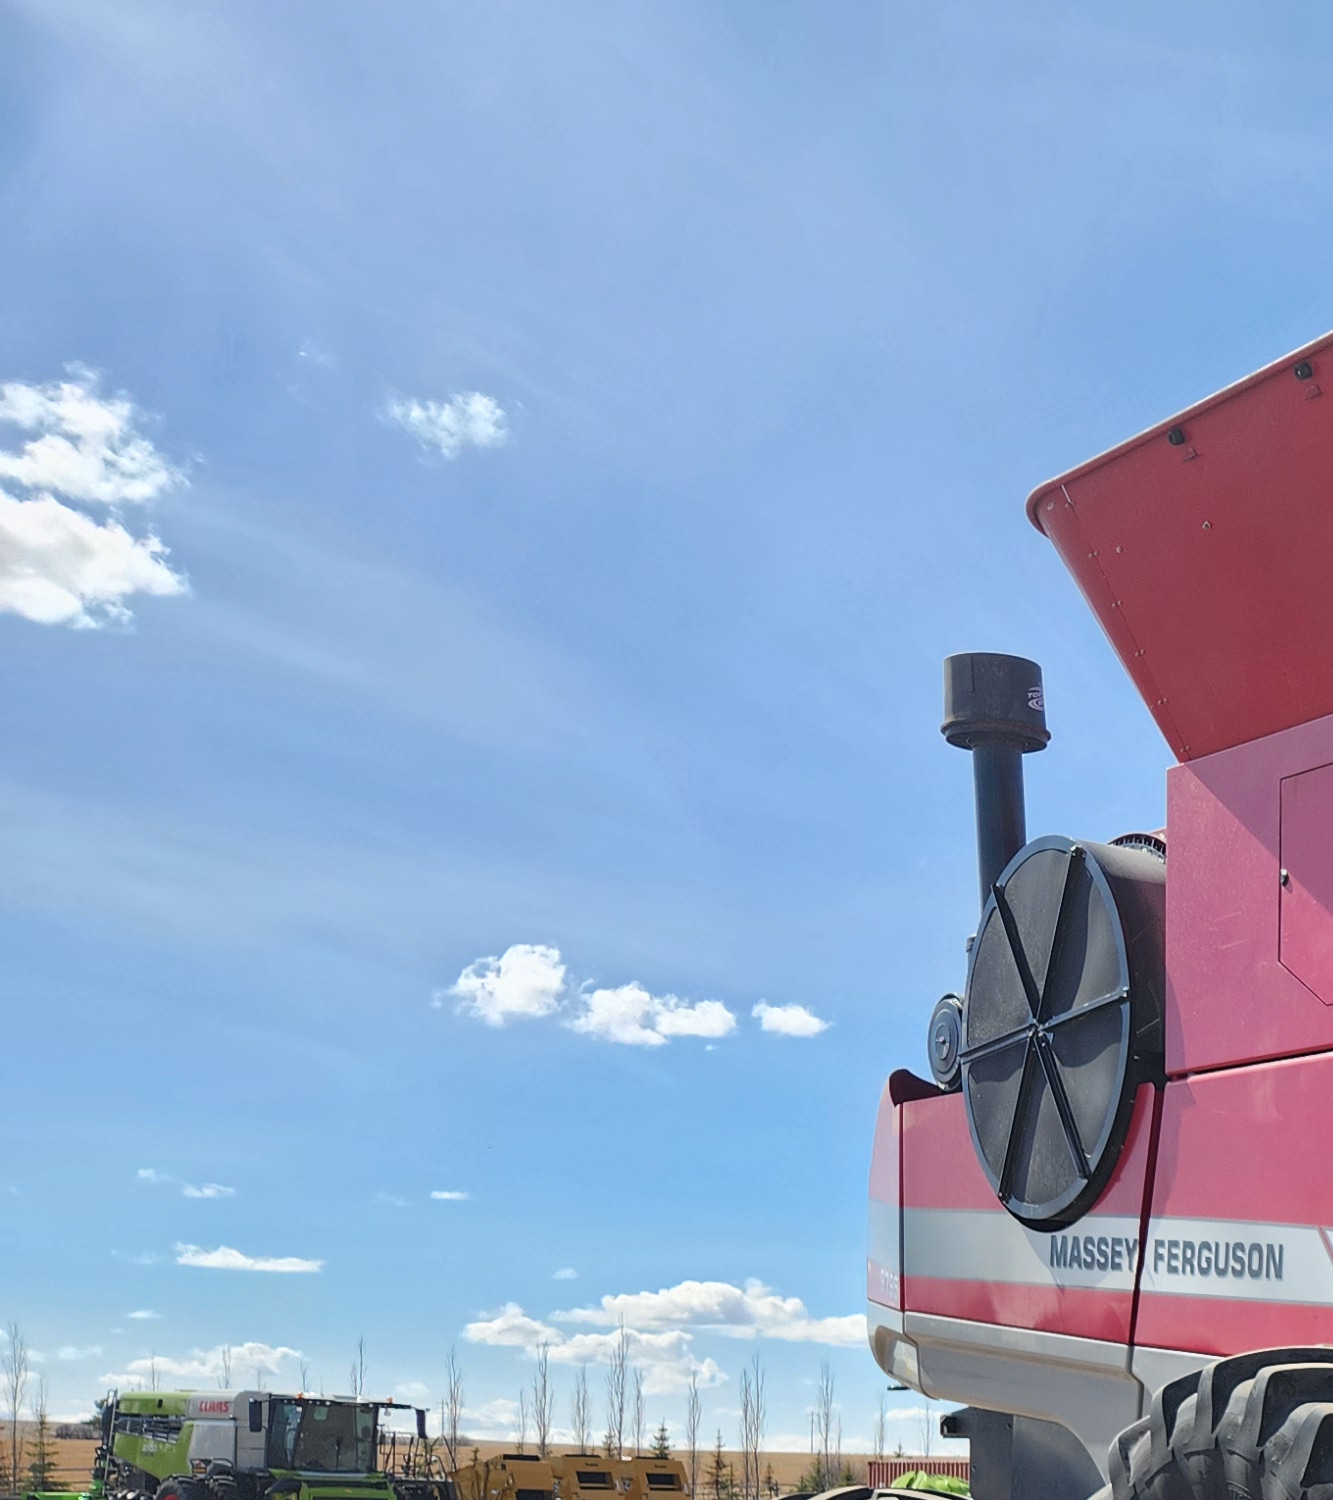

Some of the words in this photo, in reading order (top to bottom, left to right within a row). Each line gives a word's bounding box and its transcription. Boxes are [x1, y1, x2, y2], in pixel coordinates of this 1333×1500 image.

[1049, 1234, 1138, 1272] MASSEY
[1153, 1239, 1284, 1281] FERGUSON
[198, 1400, 230, 1412] CLAAS
